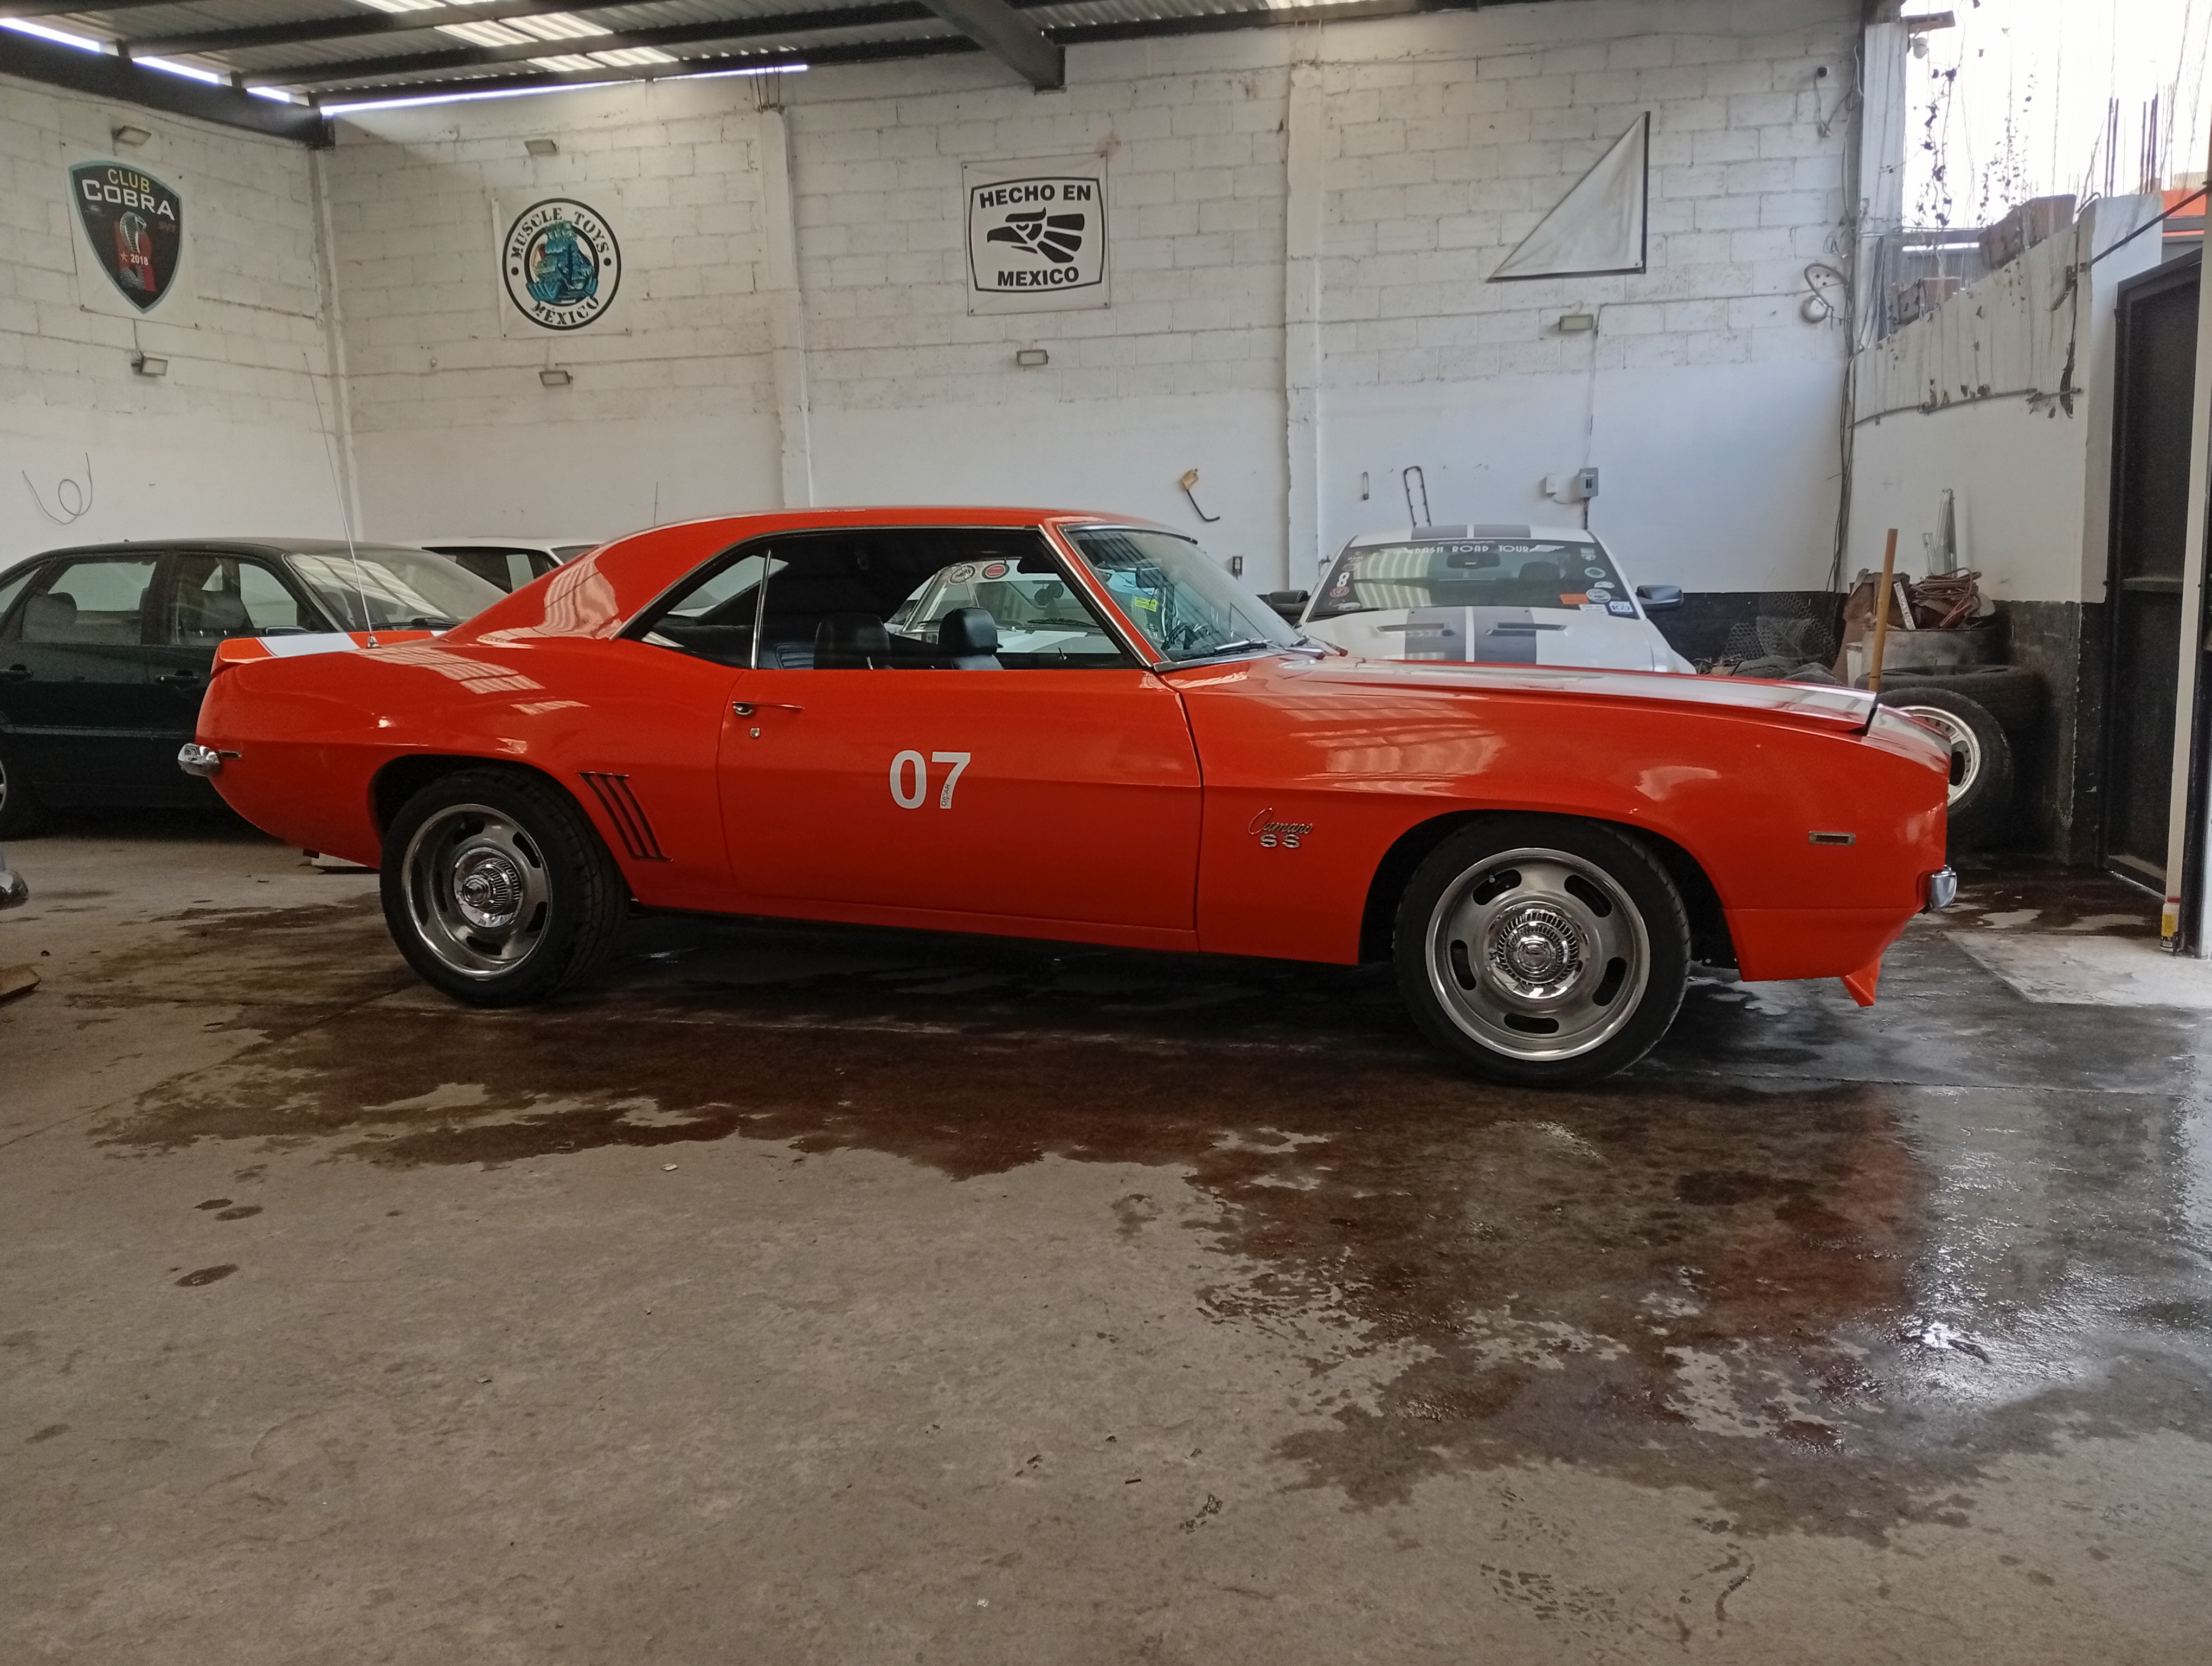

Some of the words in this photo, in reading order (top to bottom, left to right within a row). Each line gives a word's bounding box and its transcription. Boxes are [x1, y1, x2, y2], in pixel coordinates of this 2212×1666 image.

[108, 169, 151, 193] CLUB
[82, 180, 175, 221] COBRA
[979, 184, 1055, 209] HECHO
[1063, 185, 1091, 201] EN
[511, 208, 562, 261] MUSCLE
[574, 211, 609, 253] TOYS
[130, 254, 149, 266] 2018
[998, 266, 1079, 286] MEXICO
[890, 749, 970, 809] 07
[1248, 808, 1313, 834] Camaro
[1260, 834, 1300, 848] SS
